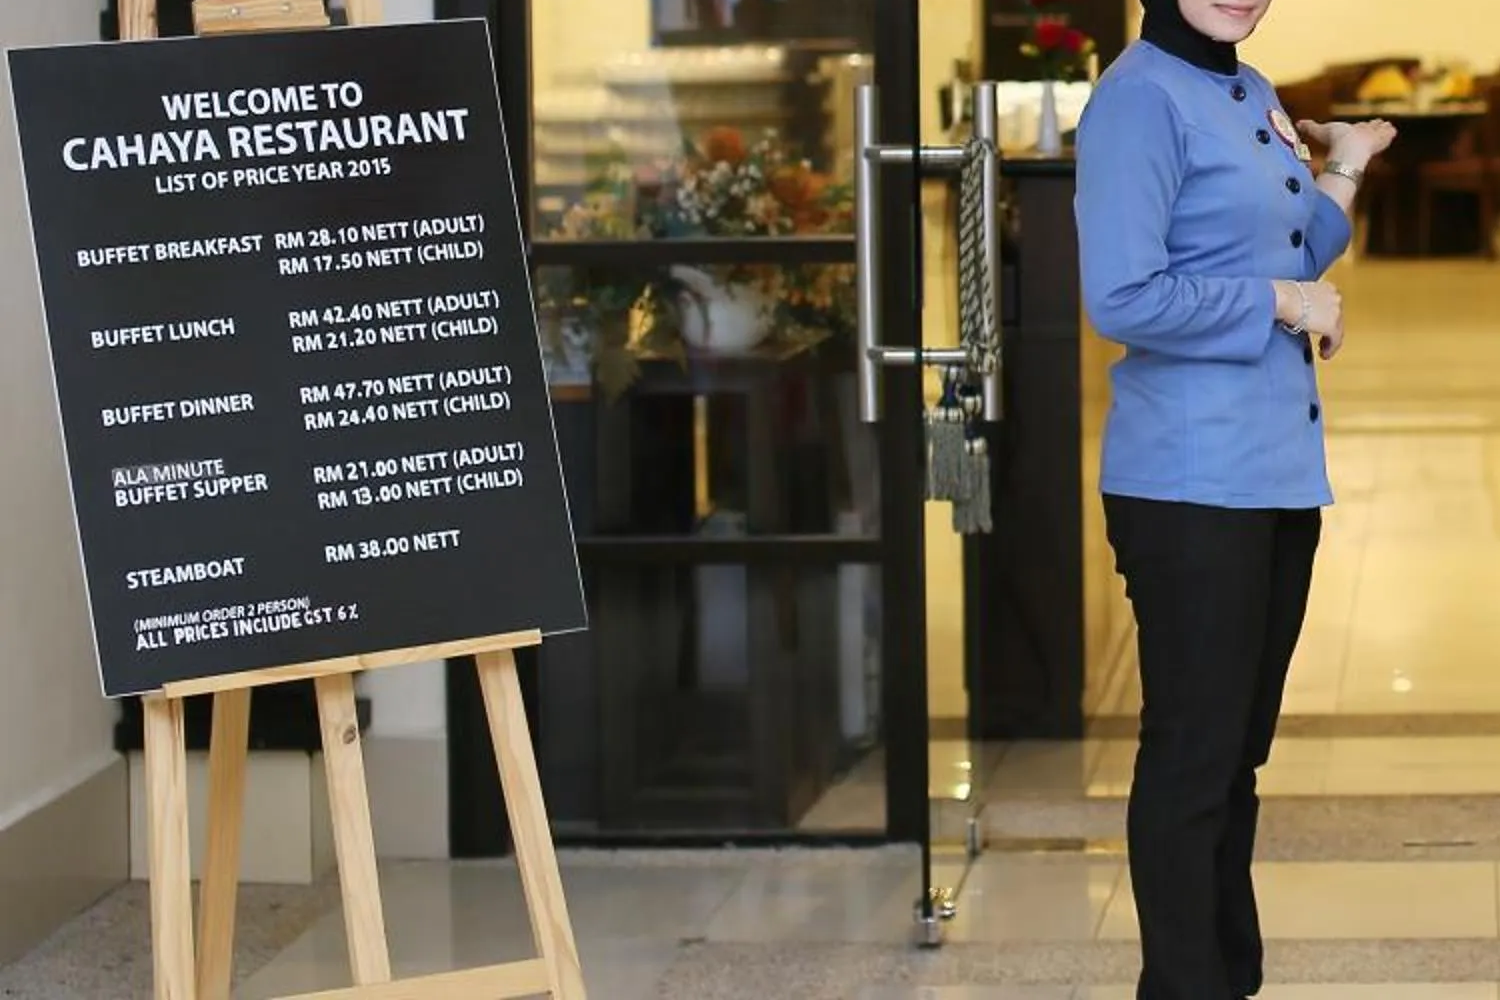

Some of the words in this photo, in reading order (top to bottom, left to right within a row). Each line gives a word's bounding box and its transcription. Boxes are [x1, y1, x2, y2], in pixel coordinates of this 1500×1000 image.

[161, 85, 318, 121] WELCOME
[321, 81, 363, 110] TO
[62, 128, 221, 171] CAHAYA
[228, 108, 469, 159] RESTAURANT
[155, 173, 197, 194] LIST
[201, 170, 230, 190] OF
[233, 165, 291, 188] PRICE
[292, 161, 345, 183] YEAR
[347, 157, 392, 178] 2015
[275, 231, 305, 251] RM
[308, 227, 359, 248] 28.10
[361, 221, 409, 244] NETT
[412, 213, 485, 239] (ADULT)
[77, 244, 152, 268] BUFFET
[154, 235, 264, 261] BREAKFAST
[279, 256, 309, 276] RM
[313, 252, 363, 272] 17.50
[366, 247, 413, 269] NETT
[417, 240, 484, 266] (CHILD)
[288, 309, 319, 329] RM
[323, 305, 373, 326] 42.40
[376, 299, 423, 320] NETT
[427, 290, 501, 317] (ADULT)
[91, 324, 164, 349] BUFFET
[168, 318, 236, 341] LUNCH
[292, 334, 322, 353] RM
[326, 329, 377, 350] 21.20
[380, 323, 428, 345] NETT
[431, 316, 499, 341] (CHILD)
[300, 385, 330, 404] RM
[333, 380, 385, 401] 47.70
[387, 373, 435, 396] NETT
[438, 365, 512, 391] (ADULT)
[102, 401, 176, 427] BUFFET
[180, 393, 255, 419] DINNER
[304, 412, 334, 431] RM
[338, 406, 389, 427] 24.40
[392, 400, 439, 422] NETT
[443, 391, 511, 417] (CHILD)
[112, 466, 148, 488] ALA
[152, 459, 225, 483] MINUTE
[313, 465, 344, 484] RM
[346, 459, 398, 481] 21.00
[401, 451, 449, 475] NETT
[452, 441, 524, 470] (ADULT)
[114, 480, 189, 507] BUFFET
[192, 473, 269, 499] SUPPER
[317, 490, 348, 510] RM
[354, 486, 403, 506] 13.00
[406, 478, 454, 501] NETT
[456, 468, 524, 496] (CHILD)
[325, 543, 355, 563] RM
[358, 537, 410, 559] 38.00
[412, 529, 462, 552] NETT
[126, 557, 246, 590] STEAMBOAT
[133, 609, 201, 633] (MINIMUM
[201, 604, 245, 623] ORDER
[247, 603, 255, 617] 2
[257, 595, 311, 616] PERSON)
[136, 629, 168, 652] ALL
[173, 621, 230, 646] PRICES
[233, 612, 302, 638] INCLUDE
